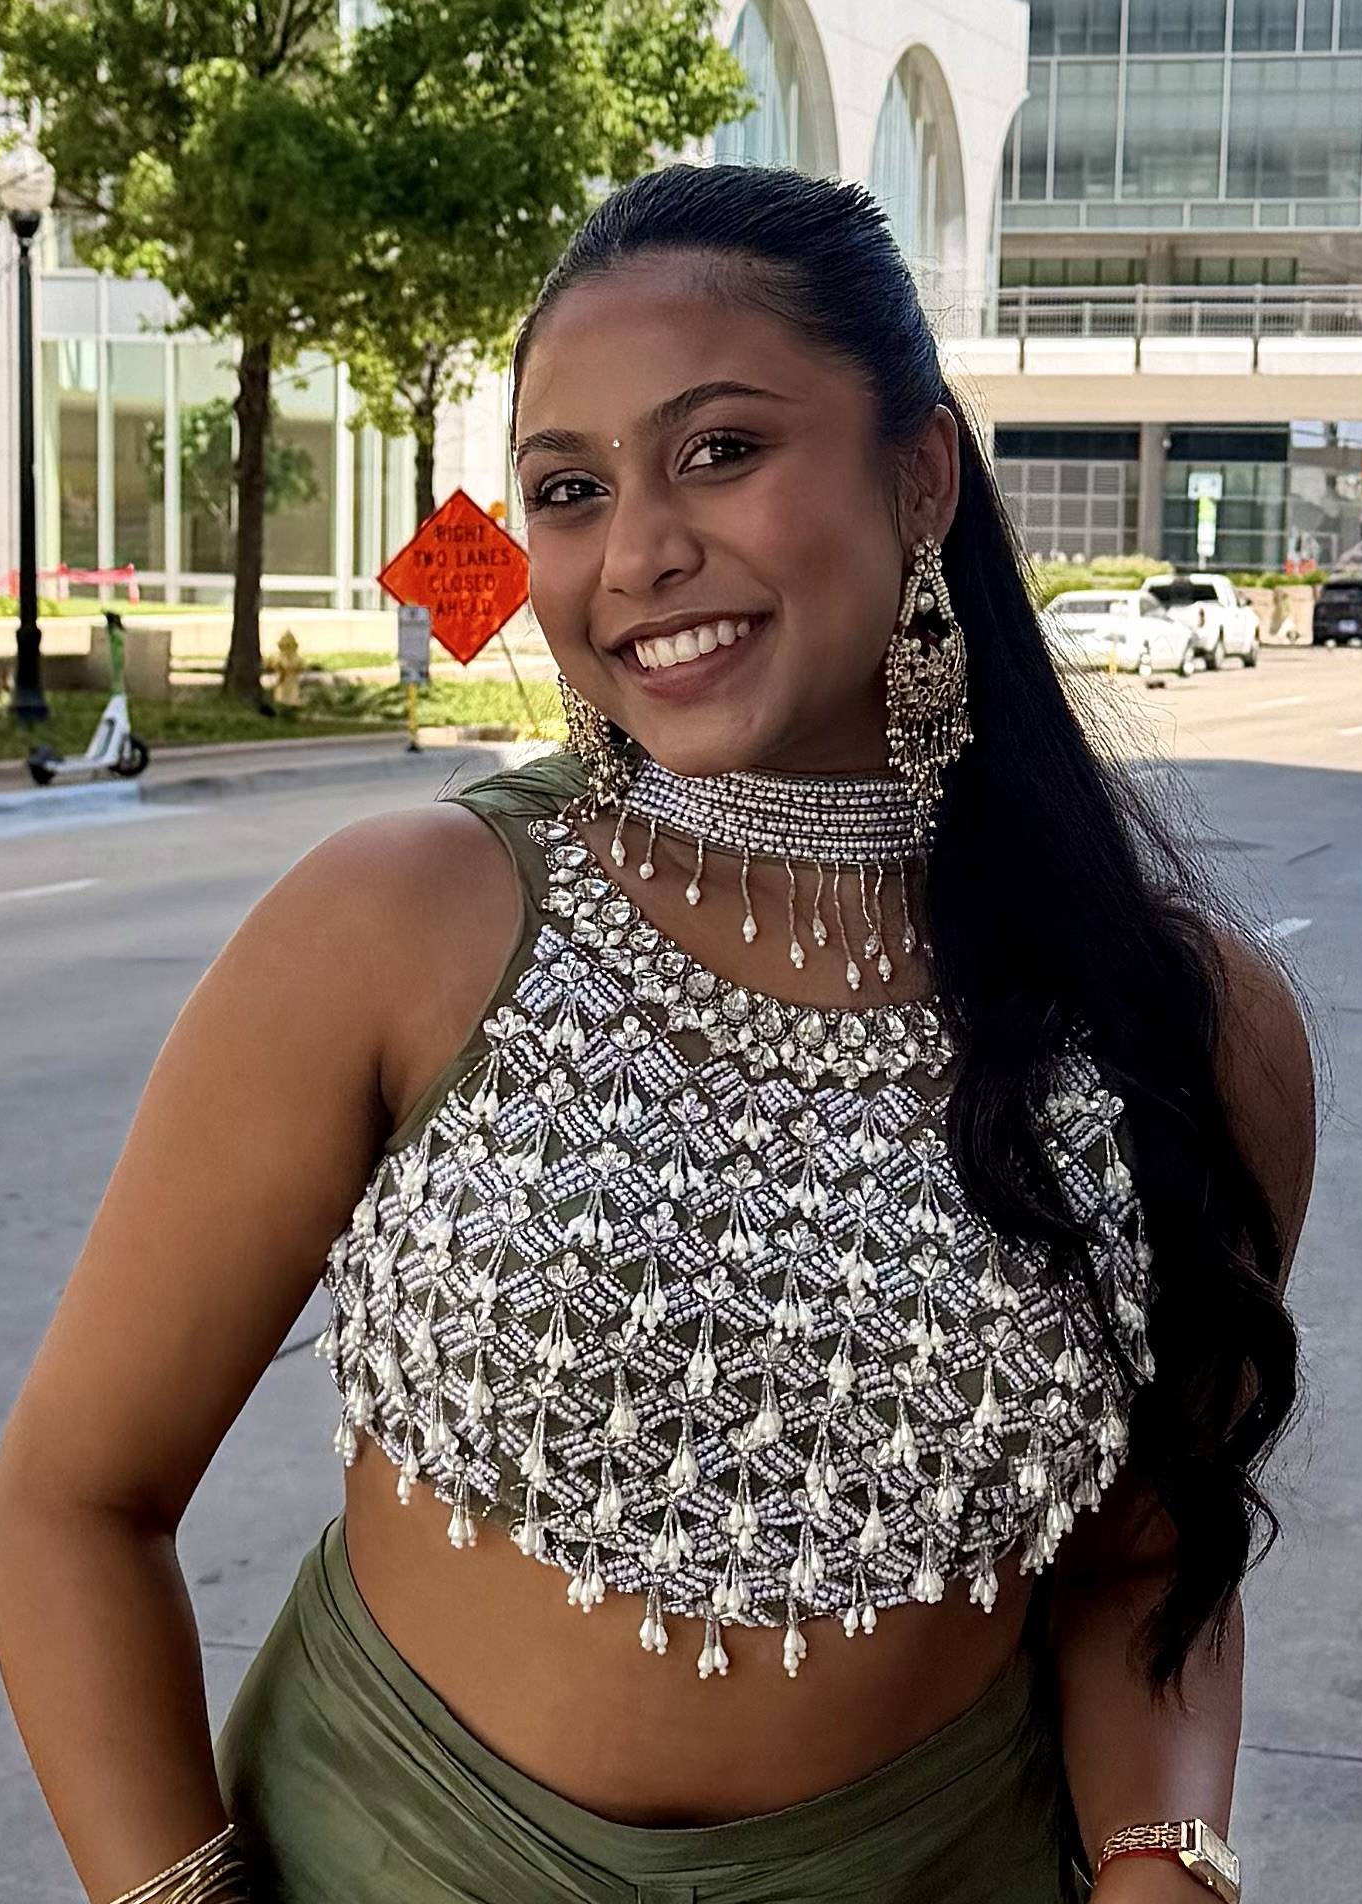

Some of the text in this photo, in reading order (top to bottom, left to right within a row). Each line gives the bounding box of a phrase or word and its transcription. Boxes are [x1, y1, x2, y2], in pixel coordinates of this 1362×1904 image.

[434, 525, 485, 542] RIGHT
[413, 548, 511, 568] TWO LANES
[429, 574, 496, 593] CLOSED
[435, 599, 493, 616] AHEAD
